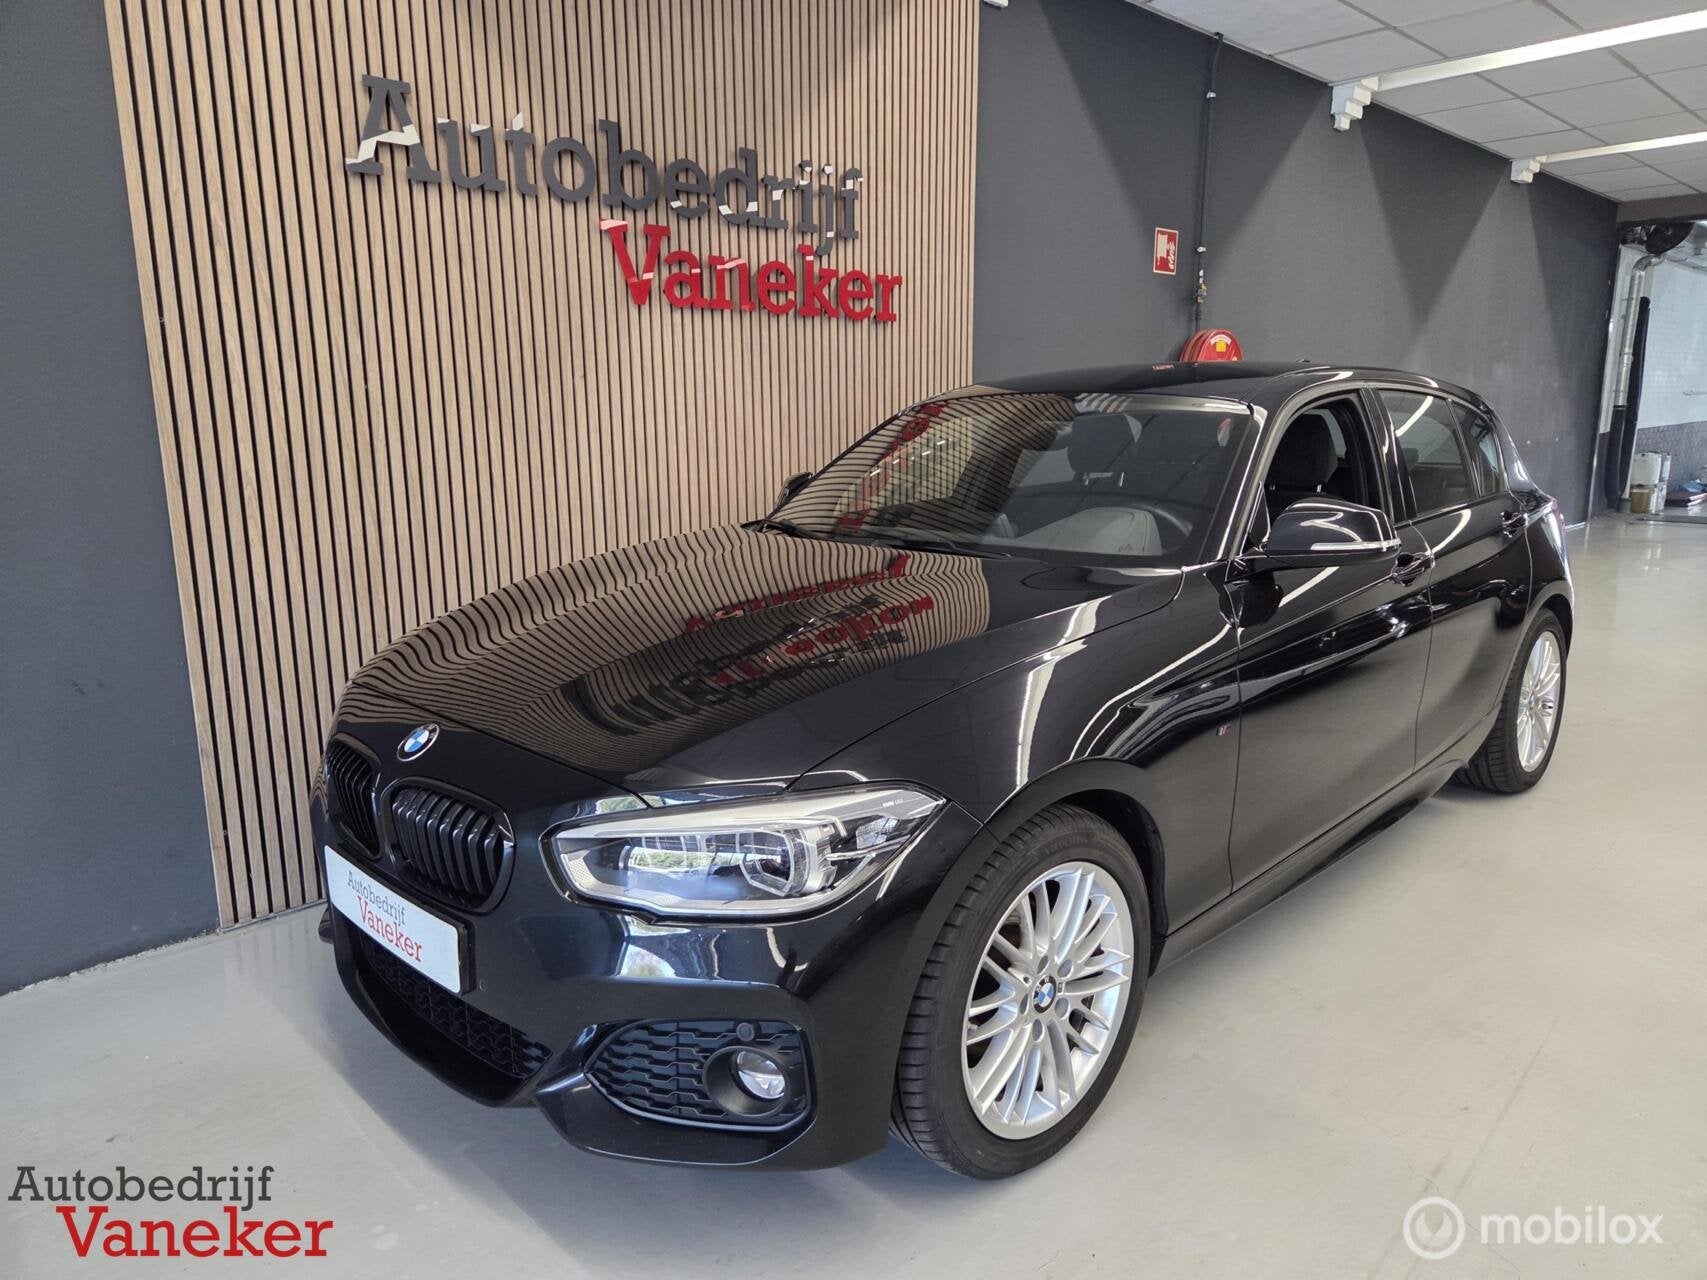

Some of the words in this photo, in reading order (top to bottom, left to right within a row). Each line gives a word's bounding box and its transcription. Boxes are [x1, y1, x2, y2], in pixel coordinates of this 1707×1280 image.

[345, 74, 863, 255] Autobedrijf
[599, 217, 903, 322] Vaneker
[347, 869, 407, 926] Autobedrijf
[357, 895, 423, 962] Vaneker
